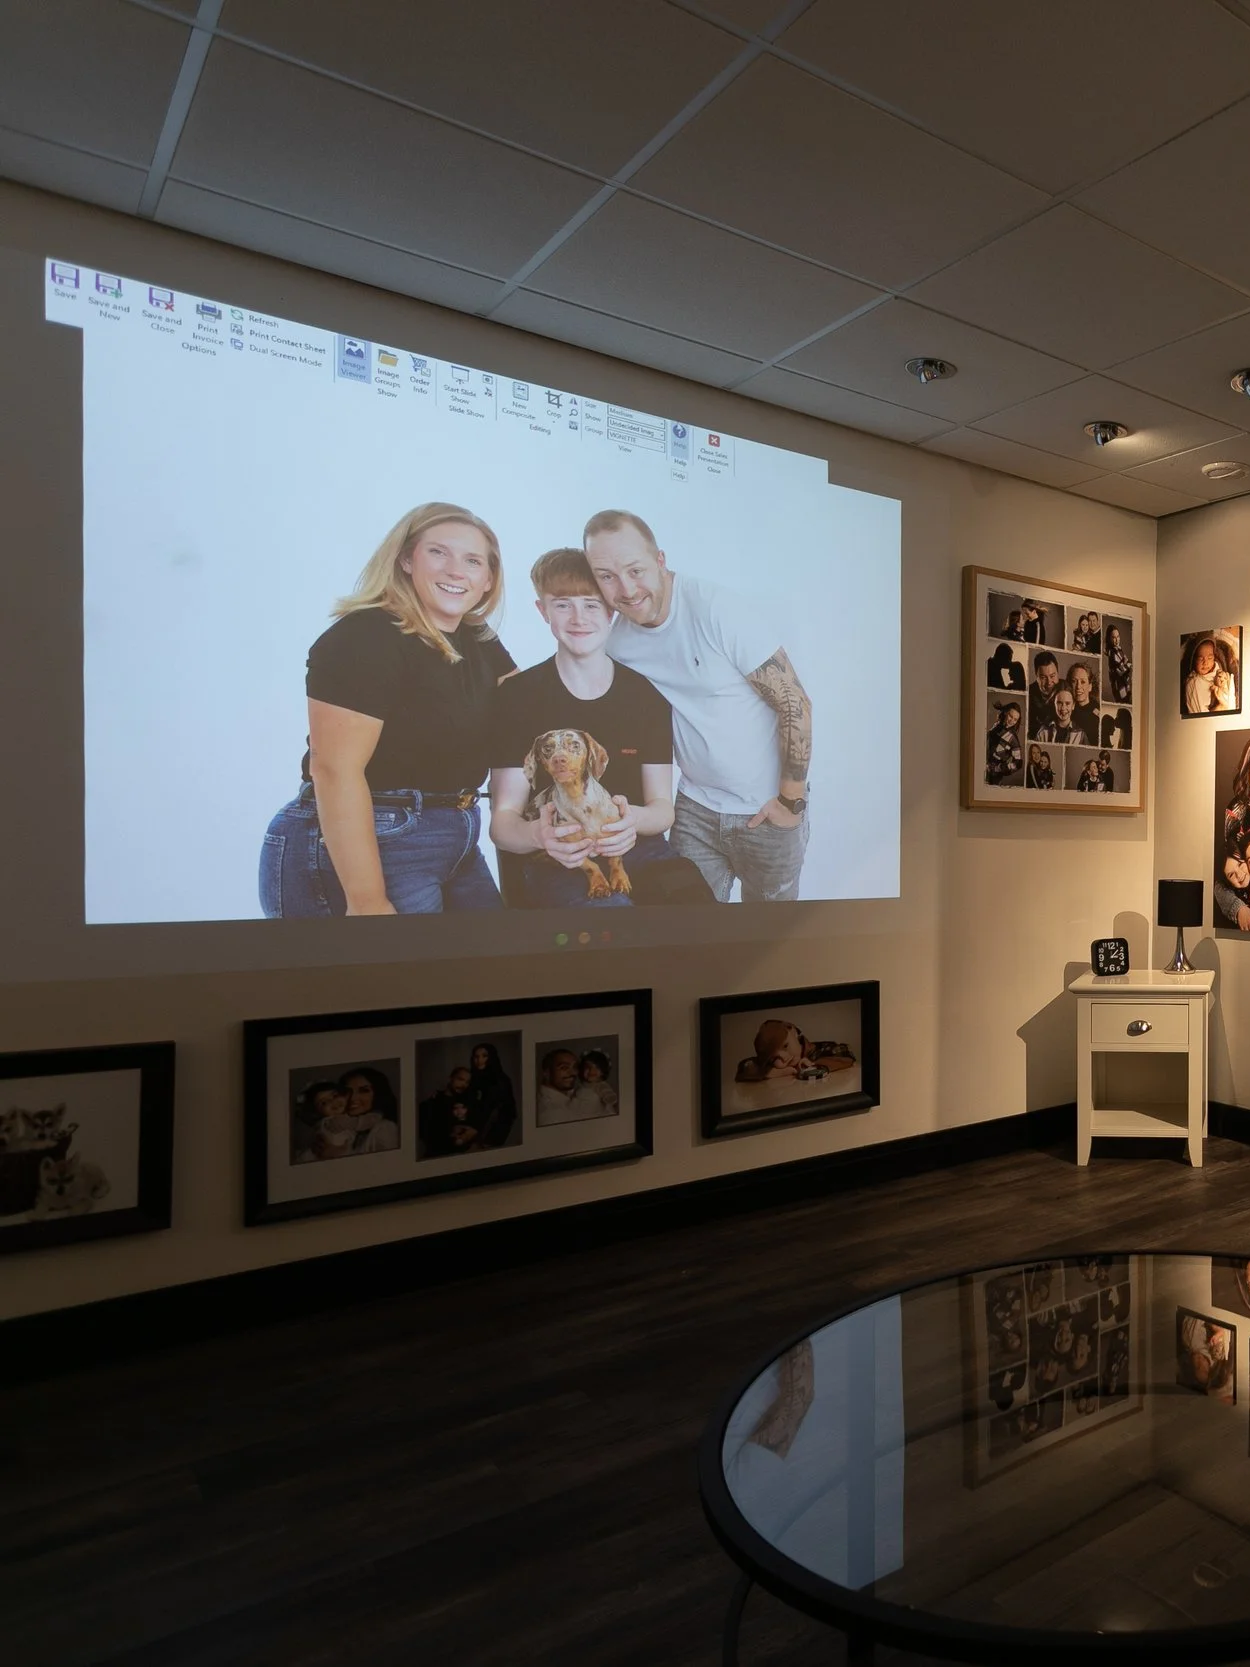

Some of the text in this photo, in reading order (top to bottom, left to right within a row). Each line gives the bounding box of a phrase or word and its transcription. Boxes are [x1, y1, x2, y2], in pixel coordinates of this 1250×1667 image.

[54, 288, 77, 300] Save
[89, 296, 130, 313] Save and
[100, 310, 120, 322] New
[142, 310, 182, 326] Save and
[249, 315, 279, 329] Refresh
[151, 322, 175, 334] Close
[198, 324, 218, 334] Print
[192, 333, 224, 346] Invoice
[250, 330, 326, 355] Print Contact Sheet
[182, 342, 216, 357] Options
[249, 344, 322, 367] Dual Screen Mode
[377, 368, 400, 380] Image
[375, 377, 400, 389] Groups
[410, 376, 430, 386] Order
[377, 388, 397, 399] Show
[413, 385, 427, 395] Info
[512, 401, 527, 410] New
[466, 409, 485, 419] Show
[502, 408, 536, 421] Composite
[547, 409, 562, 419] Crop
[529, 424, 551, 435] Editing
